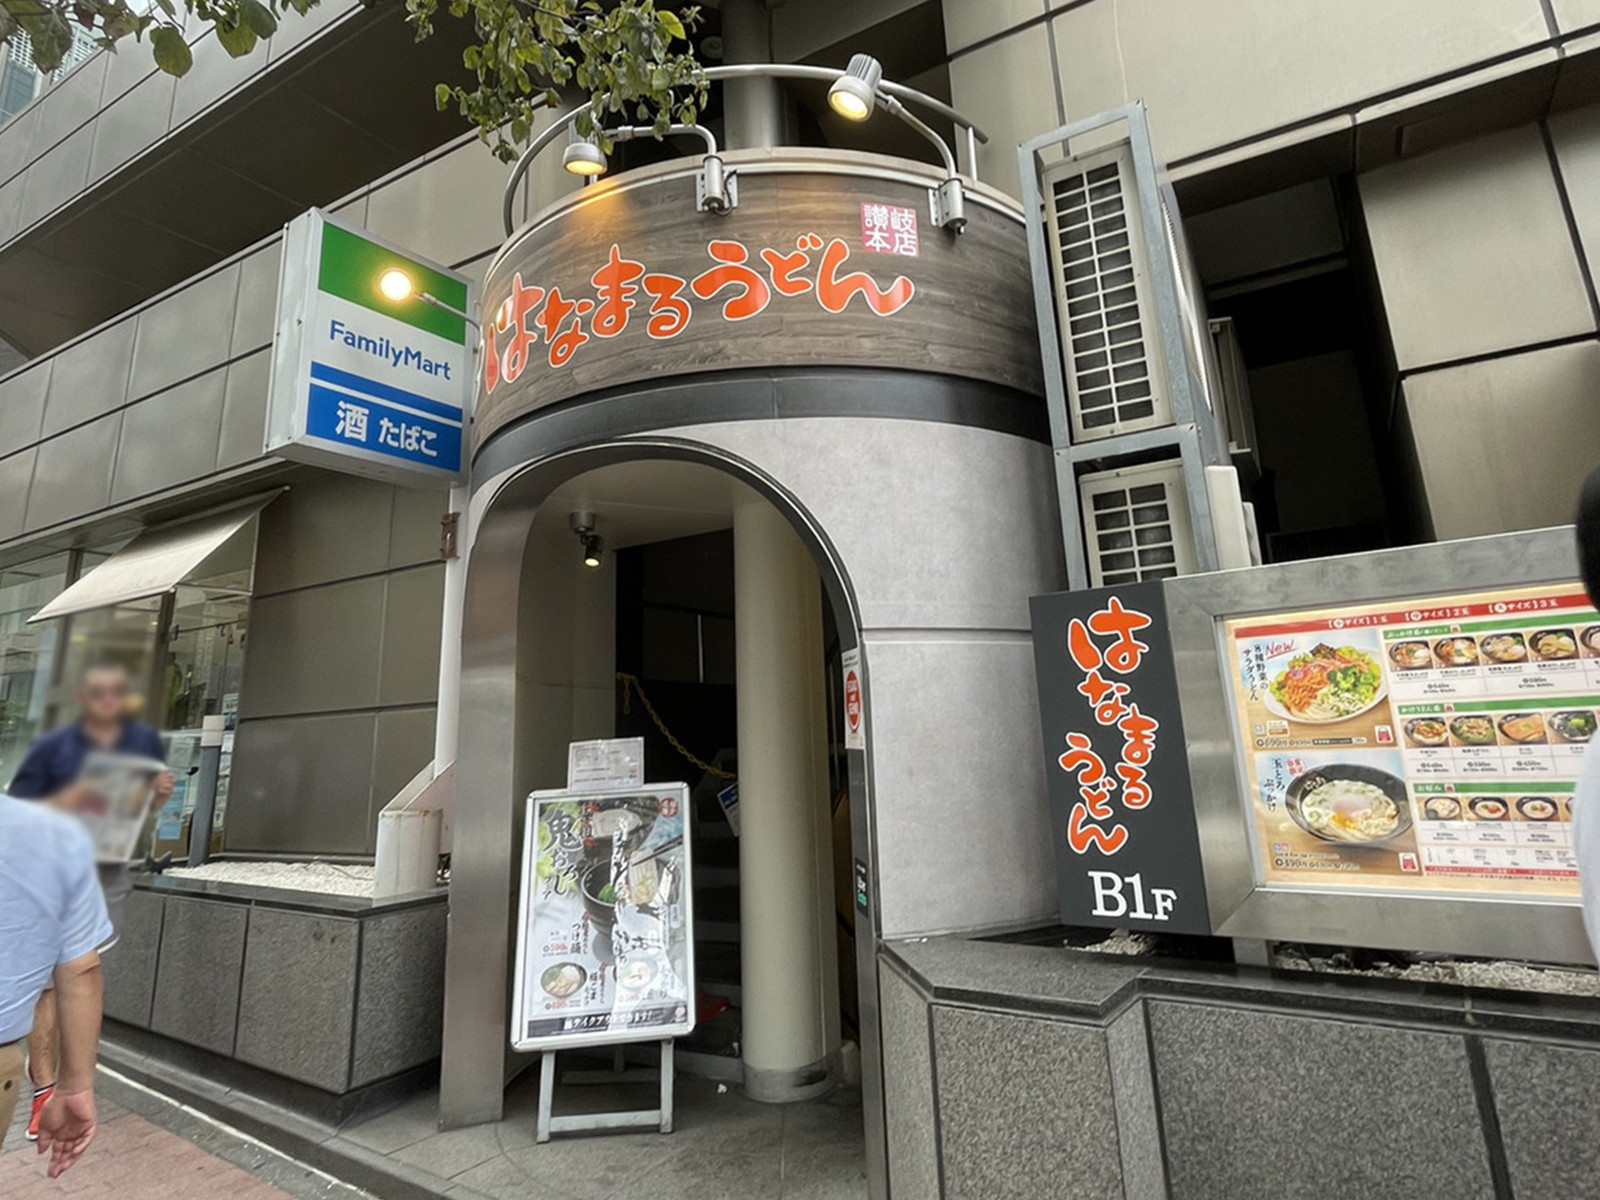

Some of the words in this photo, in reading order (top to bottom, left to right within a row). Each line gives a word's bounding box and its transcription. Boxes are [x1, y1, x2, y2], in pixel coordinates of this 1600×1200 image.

[865, 231, 917, 256] 本店
[482, 232, 915, 395] はなまるうどん
[329, 319, 451, 381] FamilyMart
[335, 400, 370, 443] 酒
[378, 417, 438, 458] たばこ
[1265, 639, 1295, 657] New
[1067, 595, 1160, 810] はなまる
[1058, 731, 1129, 855] うどん
[1087, 870, 1178, 922] B1F
